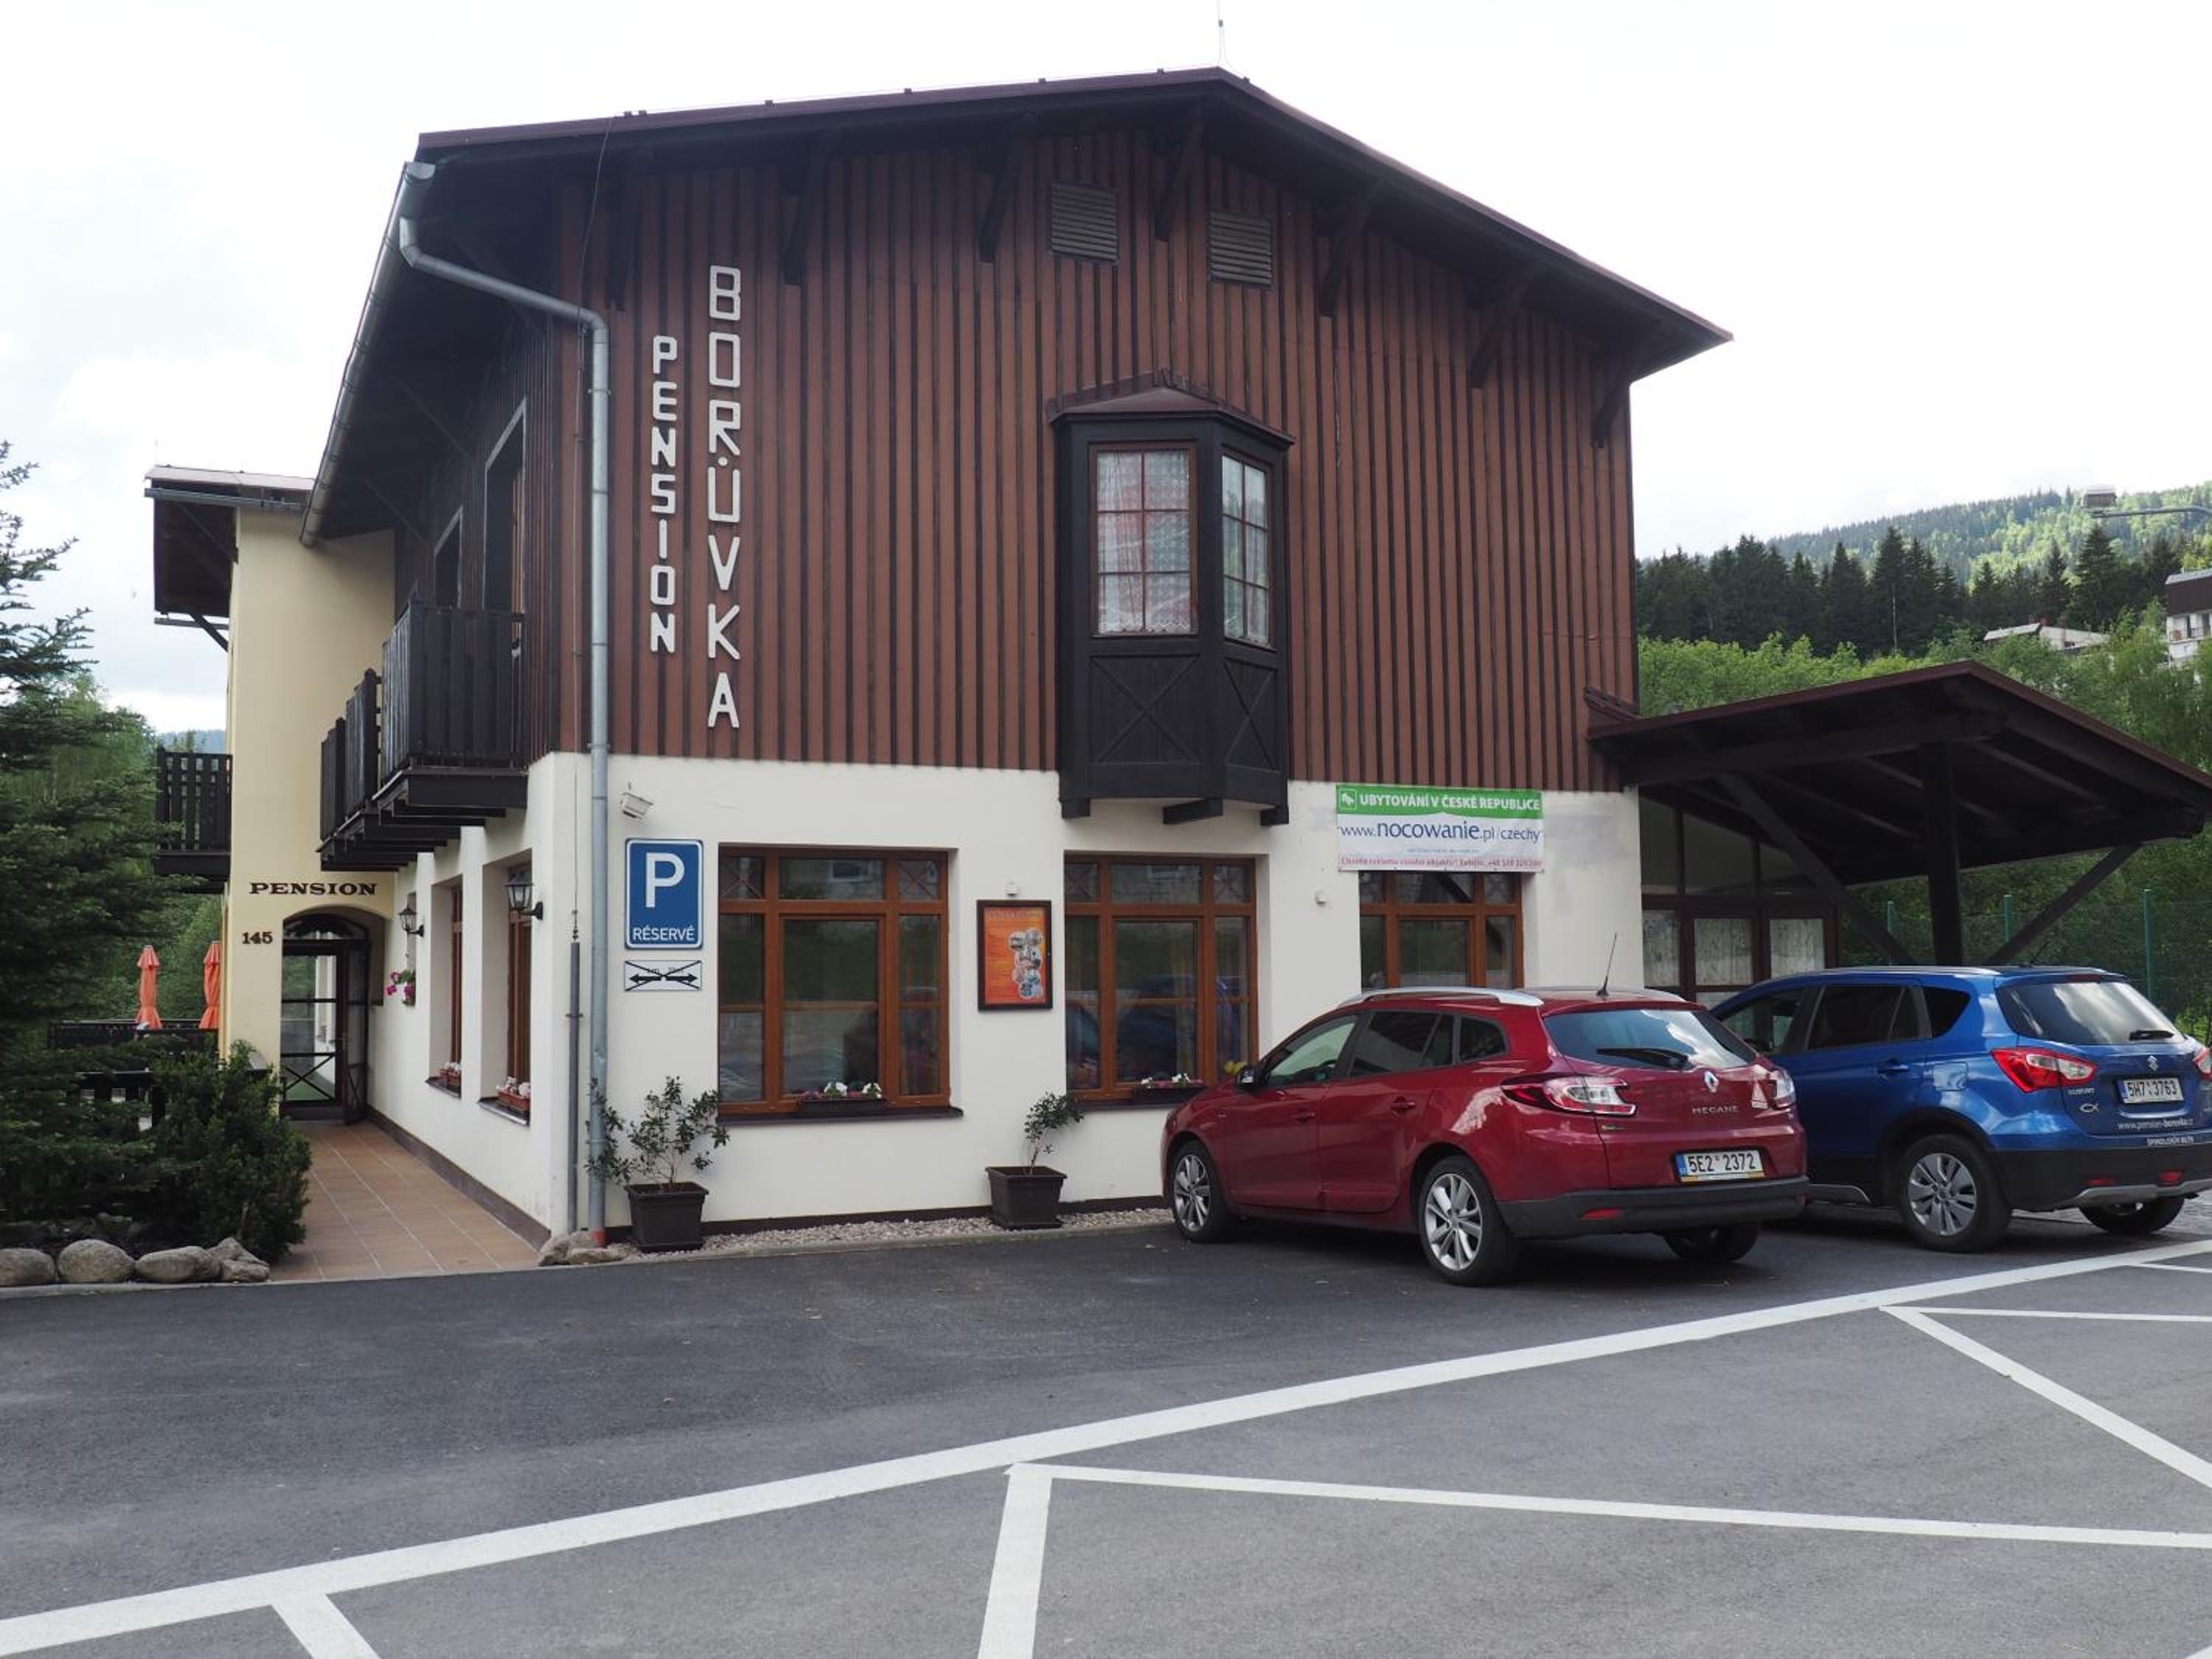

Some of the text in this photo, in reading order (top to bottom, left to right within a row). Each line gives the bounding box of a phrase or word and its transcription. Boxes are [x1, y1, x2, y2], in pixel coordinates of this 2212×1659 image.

[650, 335, 678, 653] PENSION
[1360, 793, 1540, 810] UBYTOVÁNÍ V ČESKÉ REPUBLICE
[1340, 821, 1540, 844] www.nocowanie.pl/czechy
[249, 883, 378, 895] PENSION
[645, 852, 685, 908] P
[242, 931, 273, 945] 145
[633, 925, 695, 942] RÉSERVÉ
[1688, 1155, 1714, 1172] 5E2
[1722, 1152, 1756, 1171] 2372
